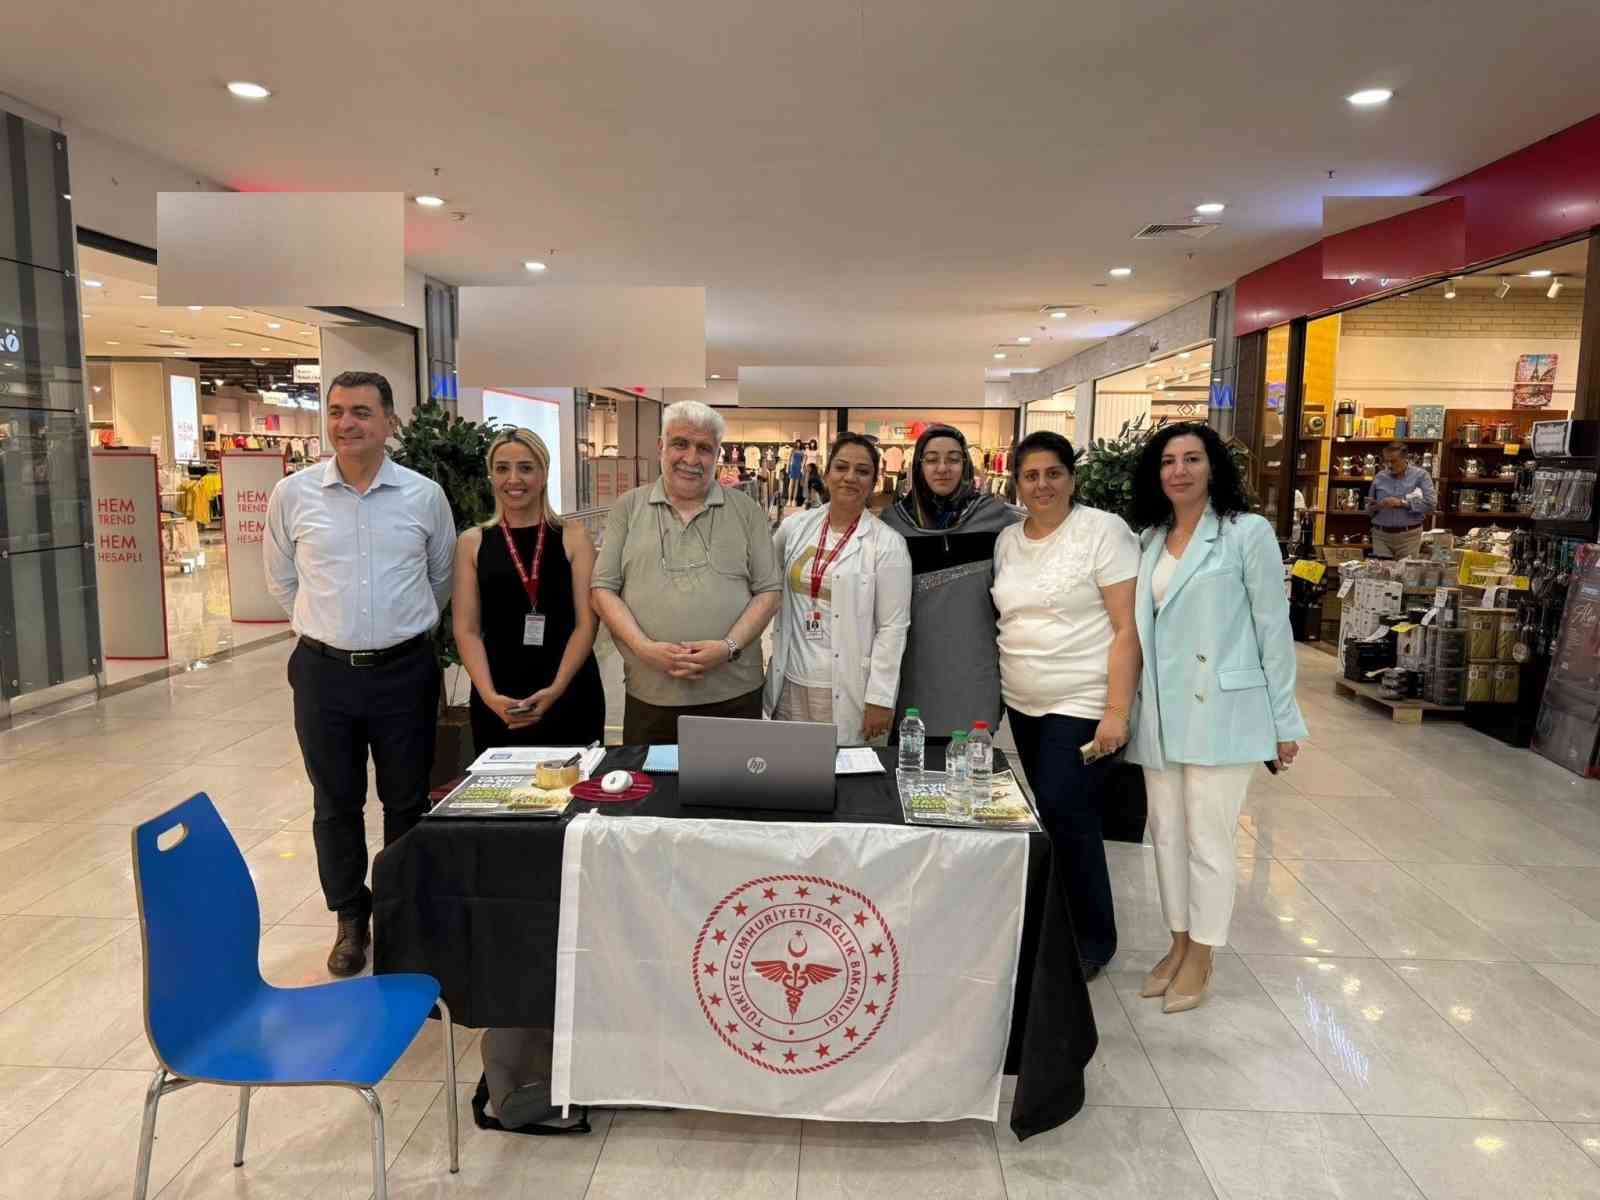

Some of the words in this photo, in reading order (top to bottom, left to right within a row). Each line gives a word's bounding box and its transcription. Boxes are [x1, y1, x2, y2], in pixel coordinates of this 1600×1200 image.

[237, 490, 268, 502] HEM
[97, 498, 135, 512] HEM
[98, 514, 136, 525] TREND
[100, 535, 137, 549] HEM
[731, 908, 812, 970] CUMHURİYETİ
[815, 912, 857, 957] SAĞLIK
[823, 960, 861, 1027] BAKANLIĞI
